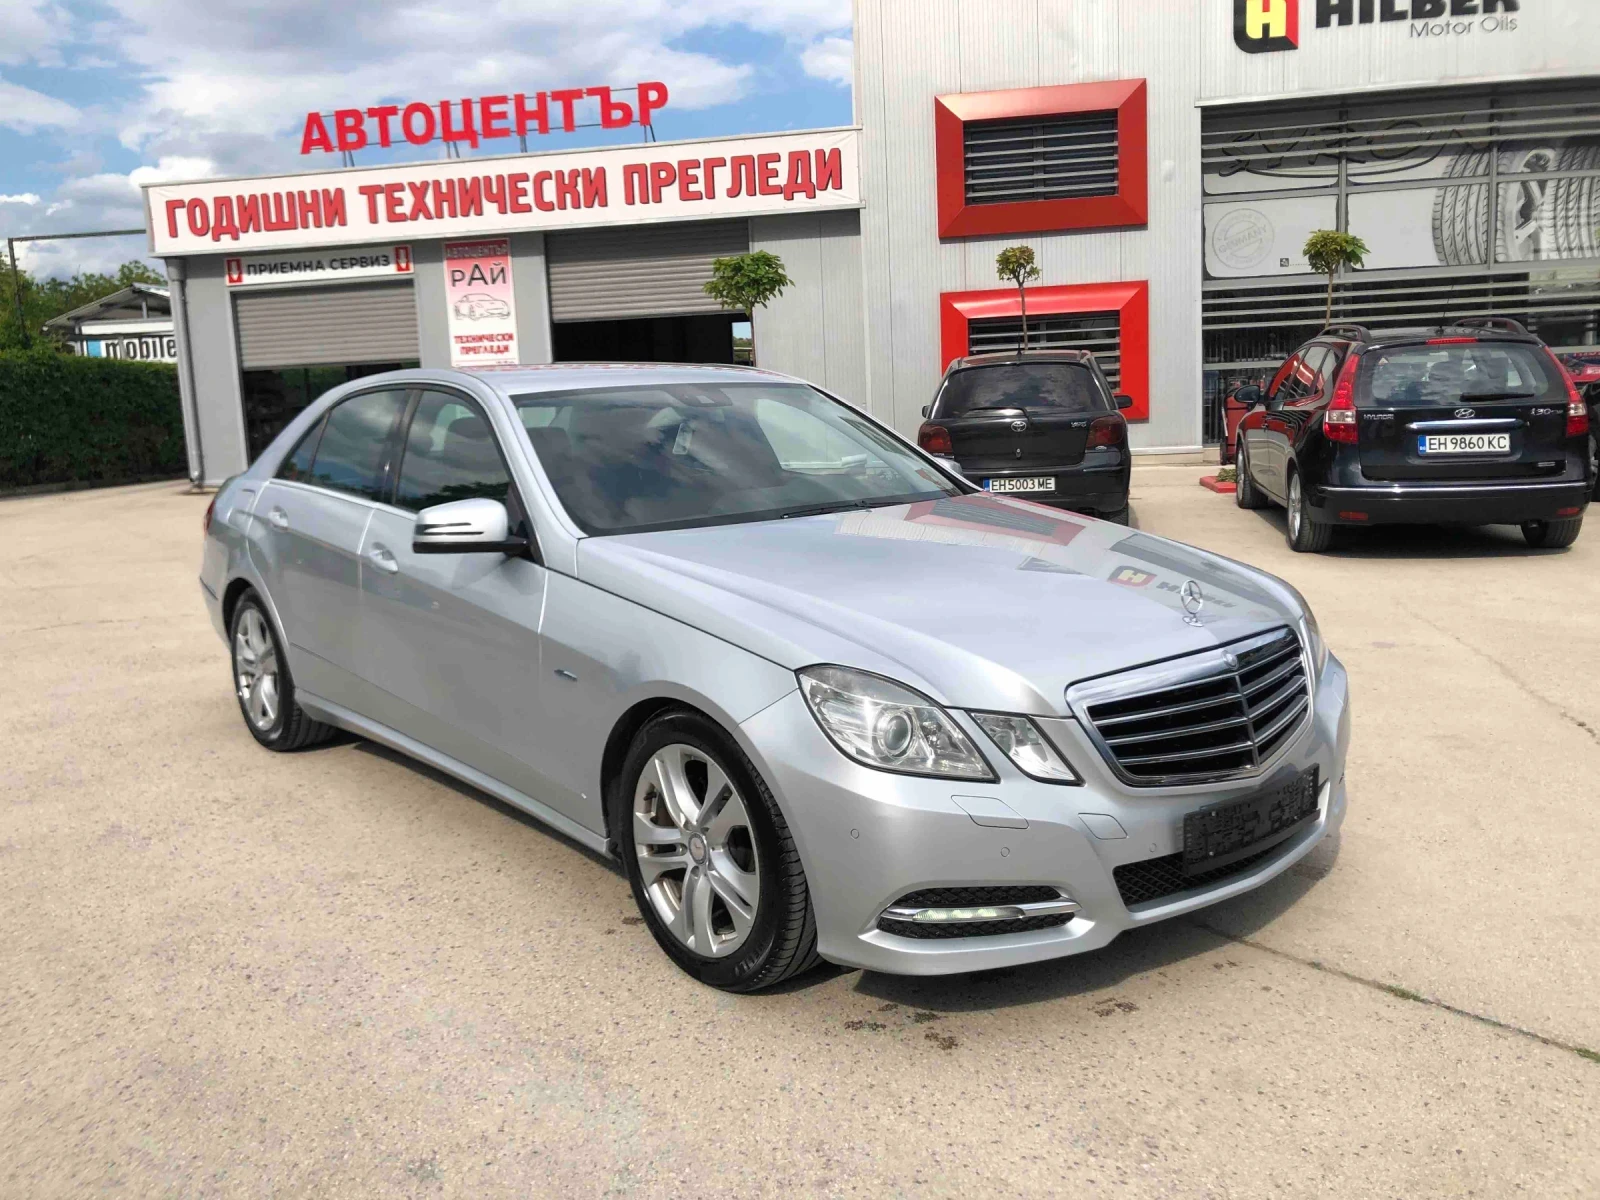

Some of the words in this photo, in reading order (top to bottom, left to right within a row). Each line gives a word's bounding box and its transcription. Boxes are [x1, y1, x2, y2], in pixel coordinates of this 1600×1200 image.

[1410, 20, 1474, 38] Motor
[1480, 15, 1518, 33] Oils
[300, 81, 668, 154] АВТОЦЕНТЪР
[166, 187, 347, 242] ГОДИШНИ
[359, 166, 608, 225] ТЕХНИЧЕСКИ
[623, 148, 842, 205] ПРЕГЛЕДИ
[247, 260, 325, 275] ПРИЕМНА
[329, 254, 390, 270] СЕРВИЗ
[450, 262, 507, 287] РАЙ
[454, 333, 514, 344] ТЕХНИЧЕСКИ
[1451, 436, 1485, 450] 9860
[1488, 436, 1507, 450] KC
